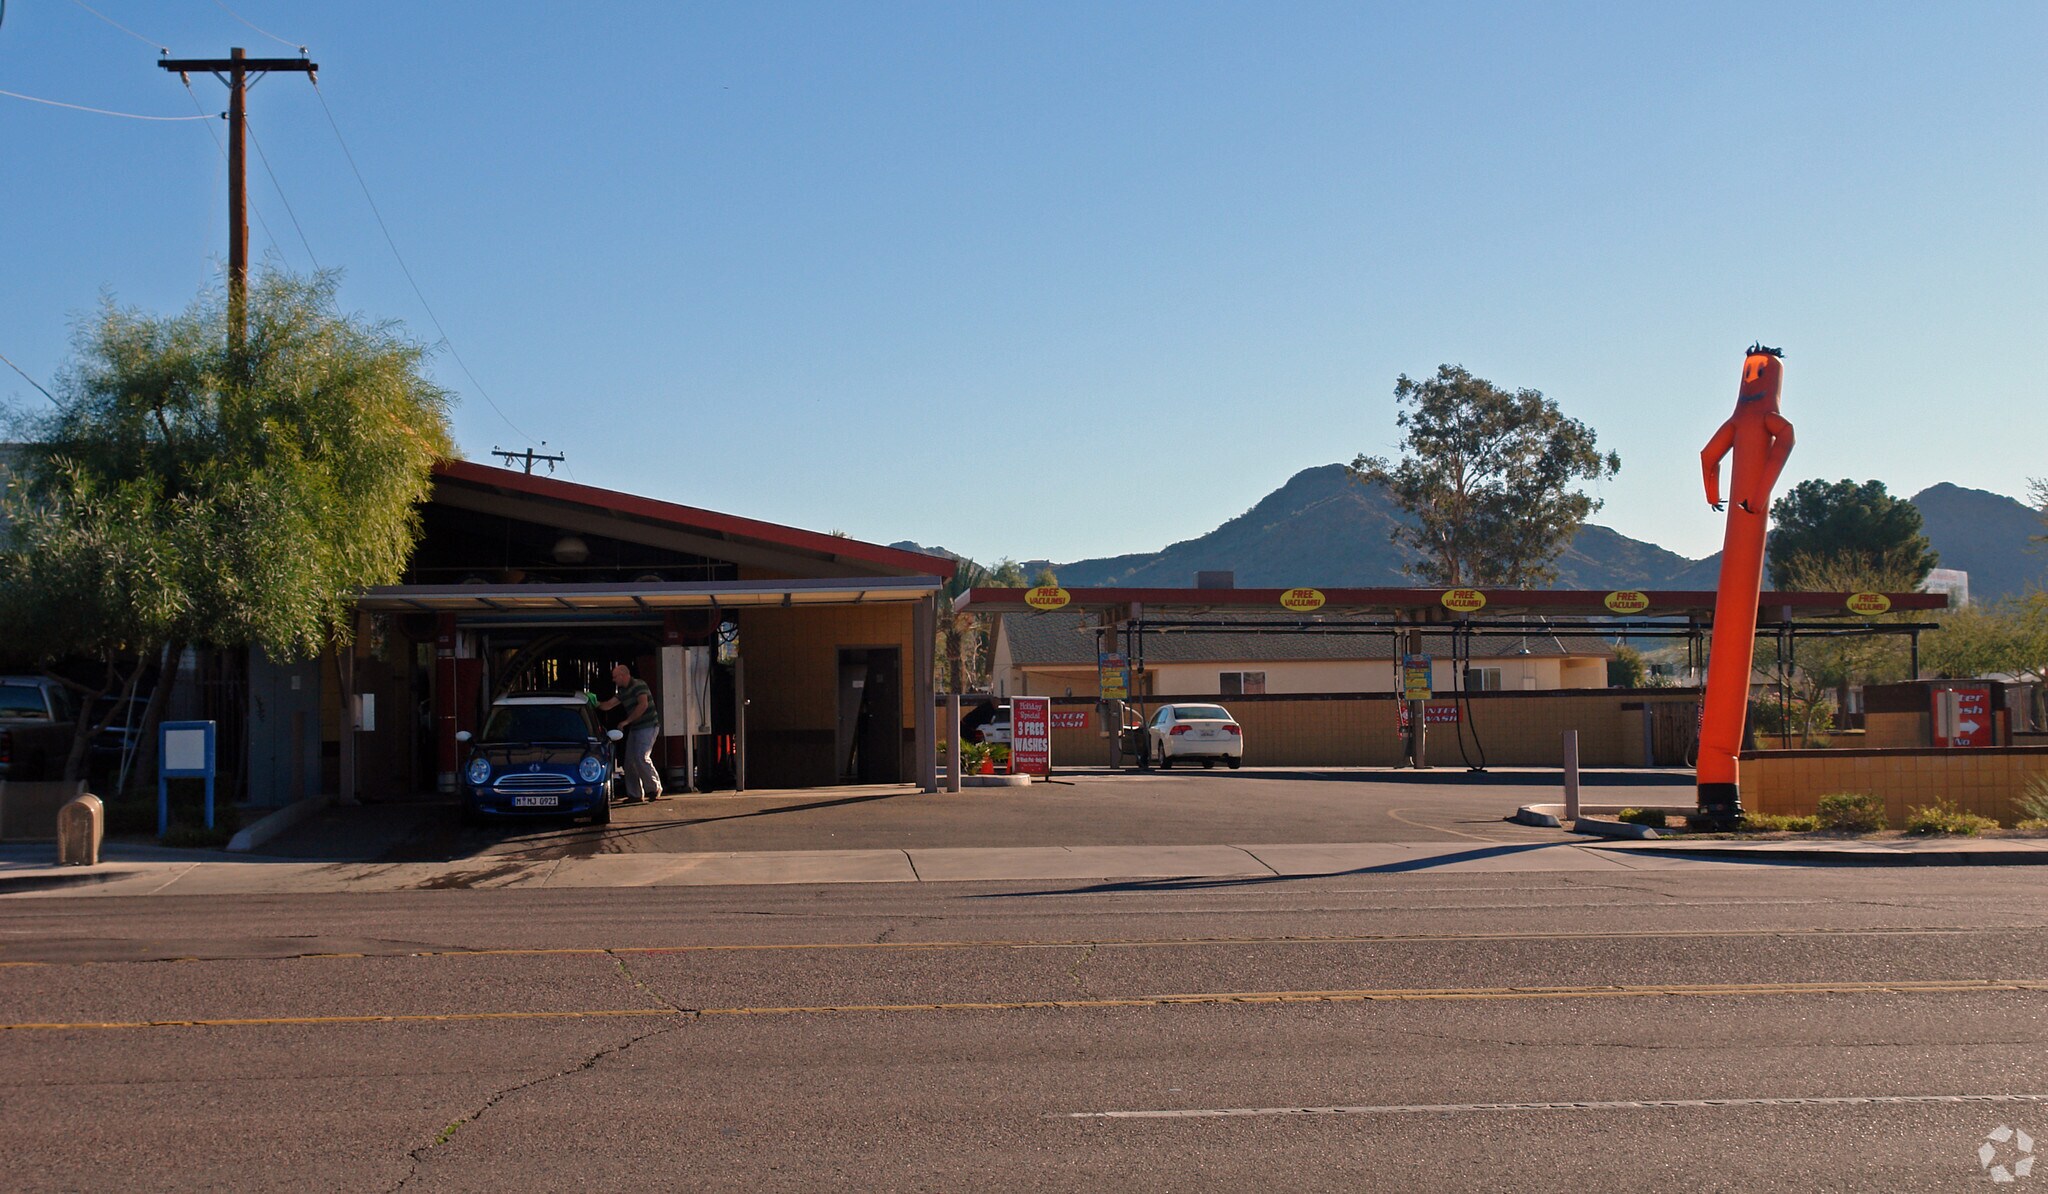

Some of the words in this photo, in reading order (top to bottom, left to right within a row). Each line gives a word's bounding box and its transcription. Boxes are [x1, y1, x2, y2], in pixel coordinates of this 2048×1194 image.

[1037, 588, 1059, 597] FREE
[1292, 590, 1314, 598] FREE
[1454, 590, 1475, 599] FREE
[1616, 592, 1638, 600] FREE
[1858, 594, 1880, 602] FREE
[1958, 694, 1983, 702] ter
[1959, 705, 1983, 714] sh
[1018, 721, 1024, 736] 3
[1025, 722, 1044, 736] FREE
[1015, 738, 1047, 752] WASHES
